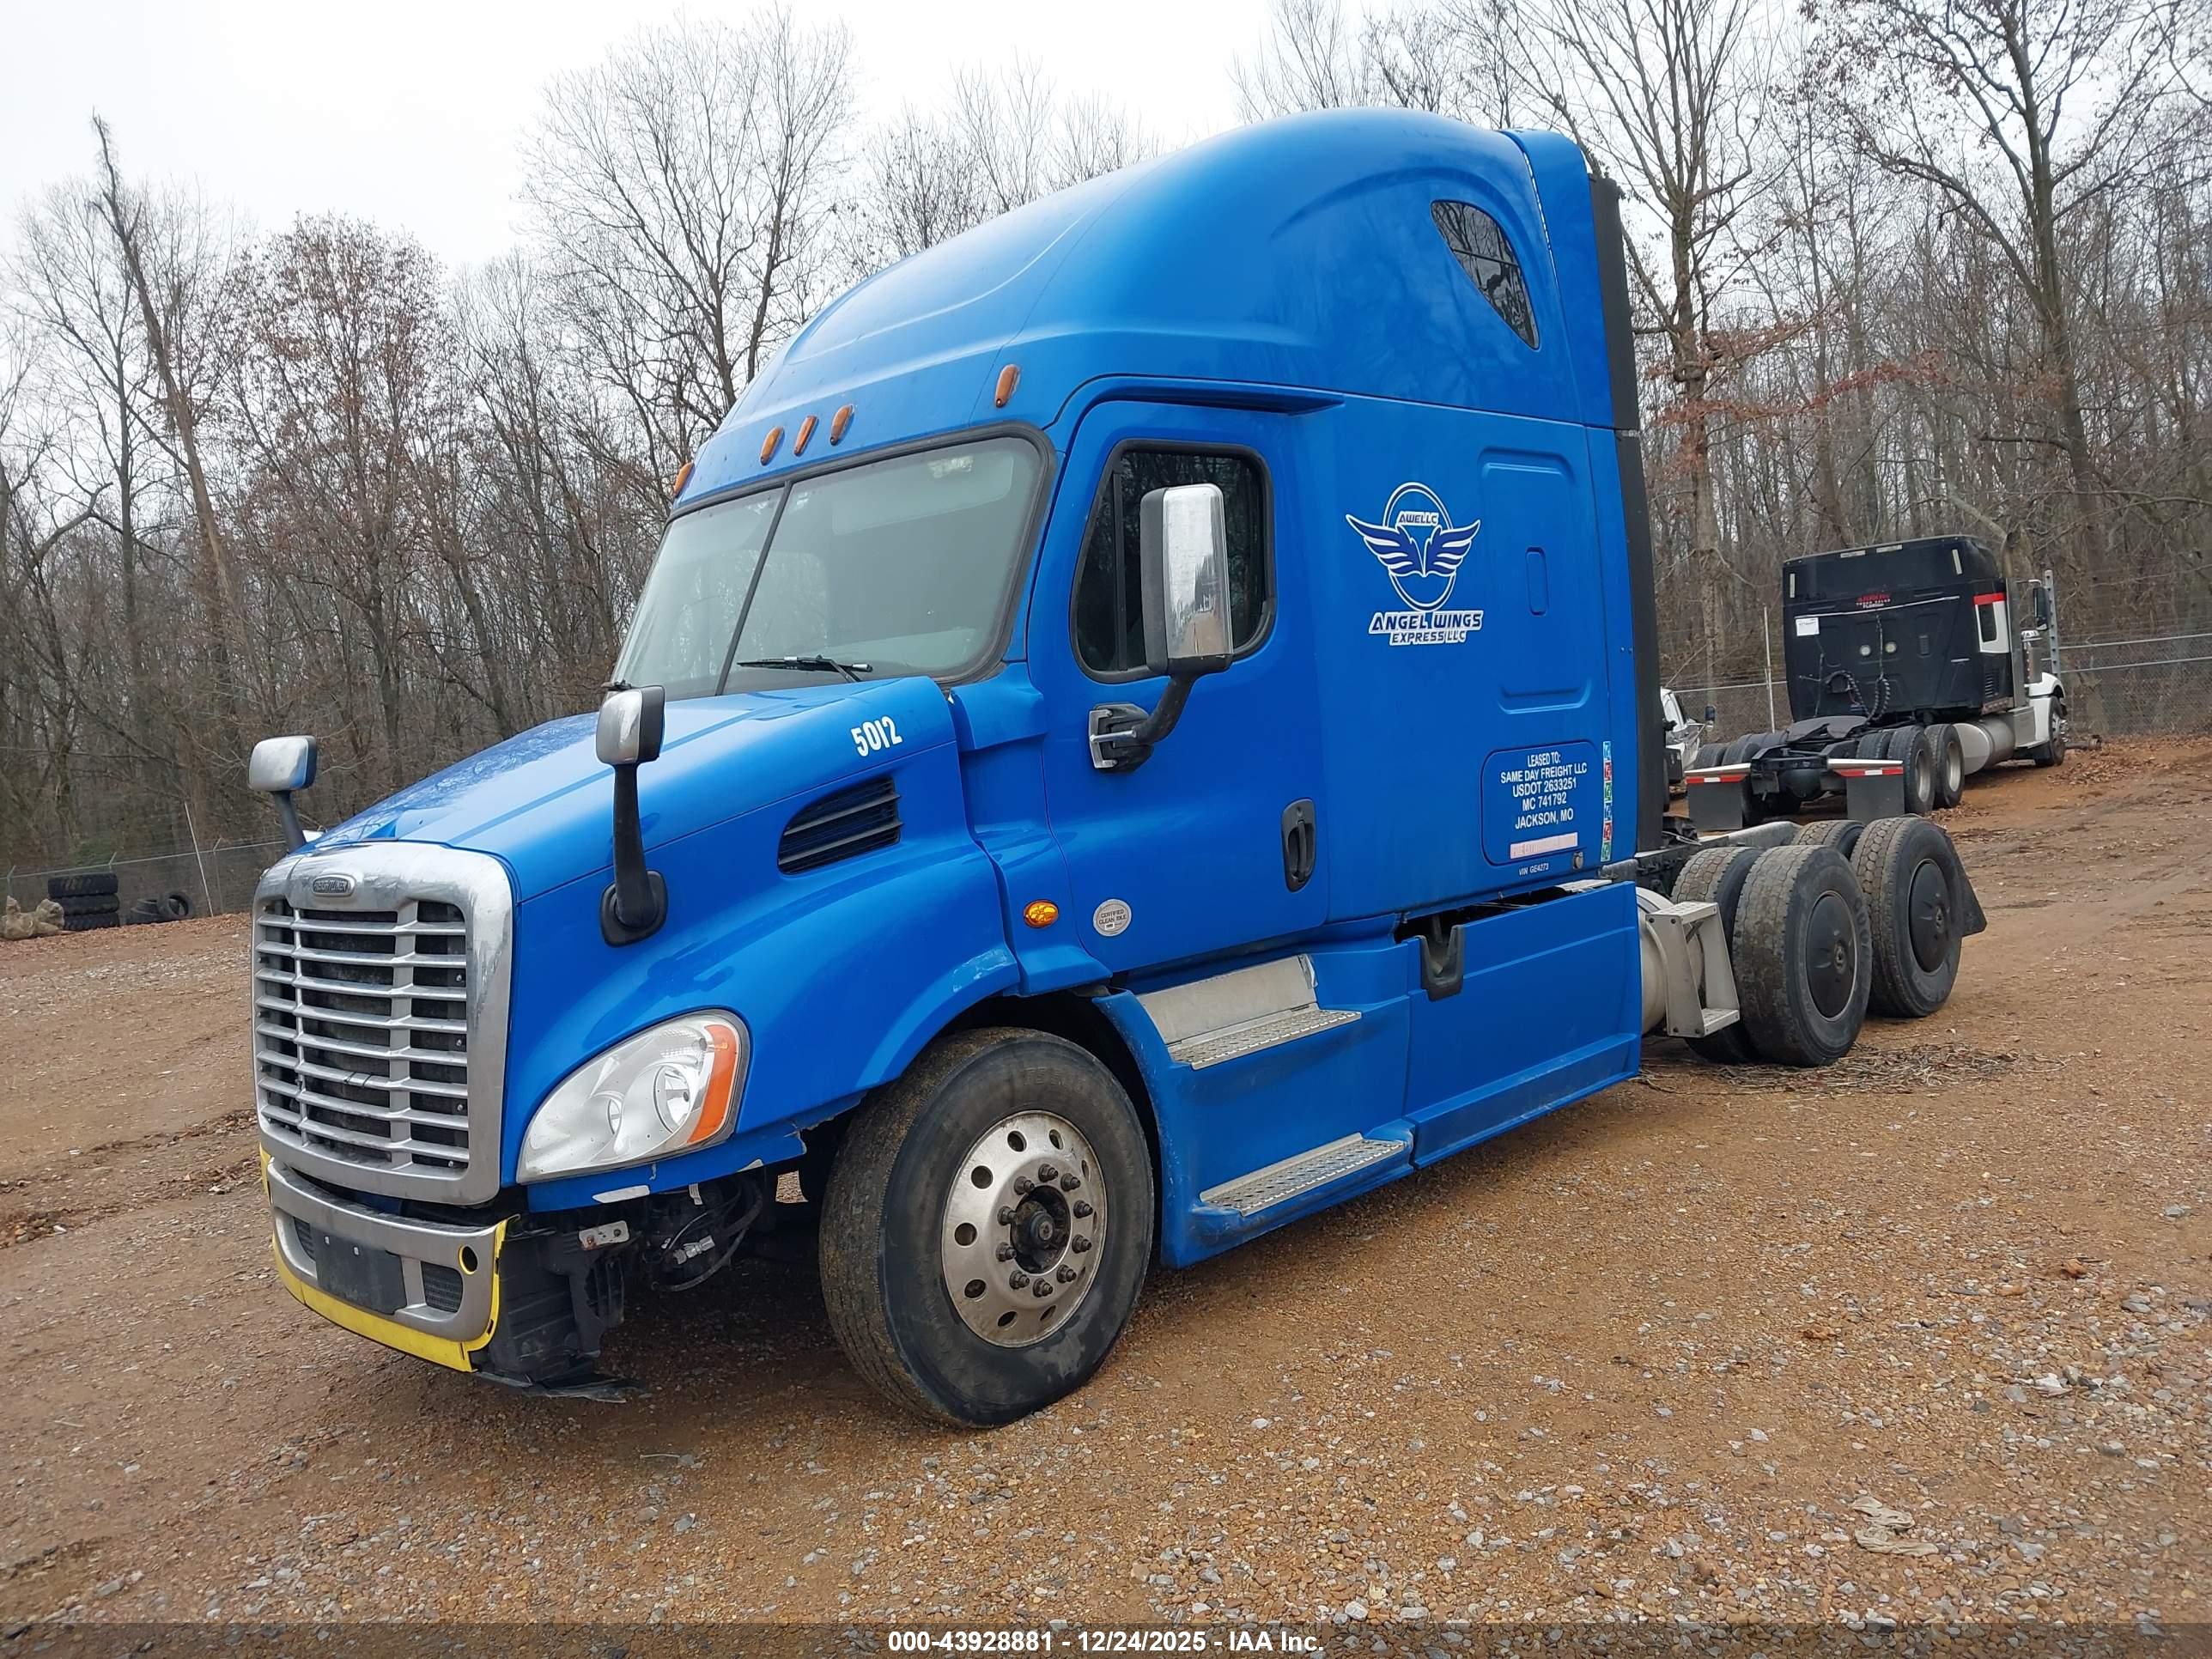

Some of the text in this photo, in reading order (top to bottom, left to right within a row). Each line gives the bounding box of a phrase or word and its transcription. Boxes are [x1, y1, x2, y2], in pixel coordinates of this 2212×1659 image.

[1399, 514, 1437, 524] AWELLC
[1372, 613, 1481, 630] ANGEL WINGS
[1392, 630, 1465, 643] EXPRESS LLC
[851, 716, 902, 757] 5012
[1528, 751, 1561, 767] LEASED TO:
[1501, 763, 1588, 783] SAME DAY FREIGHT LLC
[1512, 778, 1577, 797] USDOT 2633251
[1522, 792, 1566, 811] MC 741792
[1515, 808, 1574, 829] JACKSON, MO
[1519, 867, 1528, 876] VIN
[1101, 909, 1124, 918] CERTIFIED
